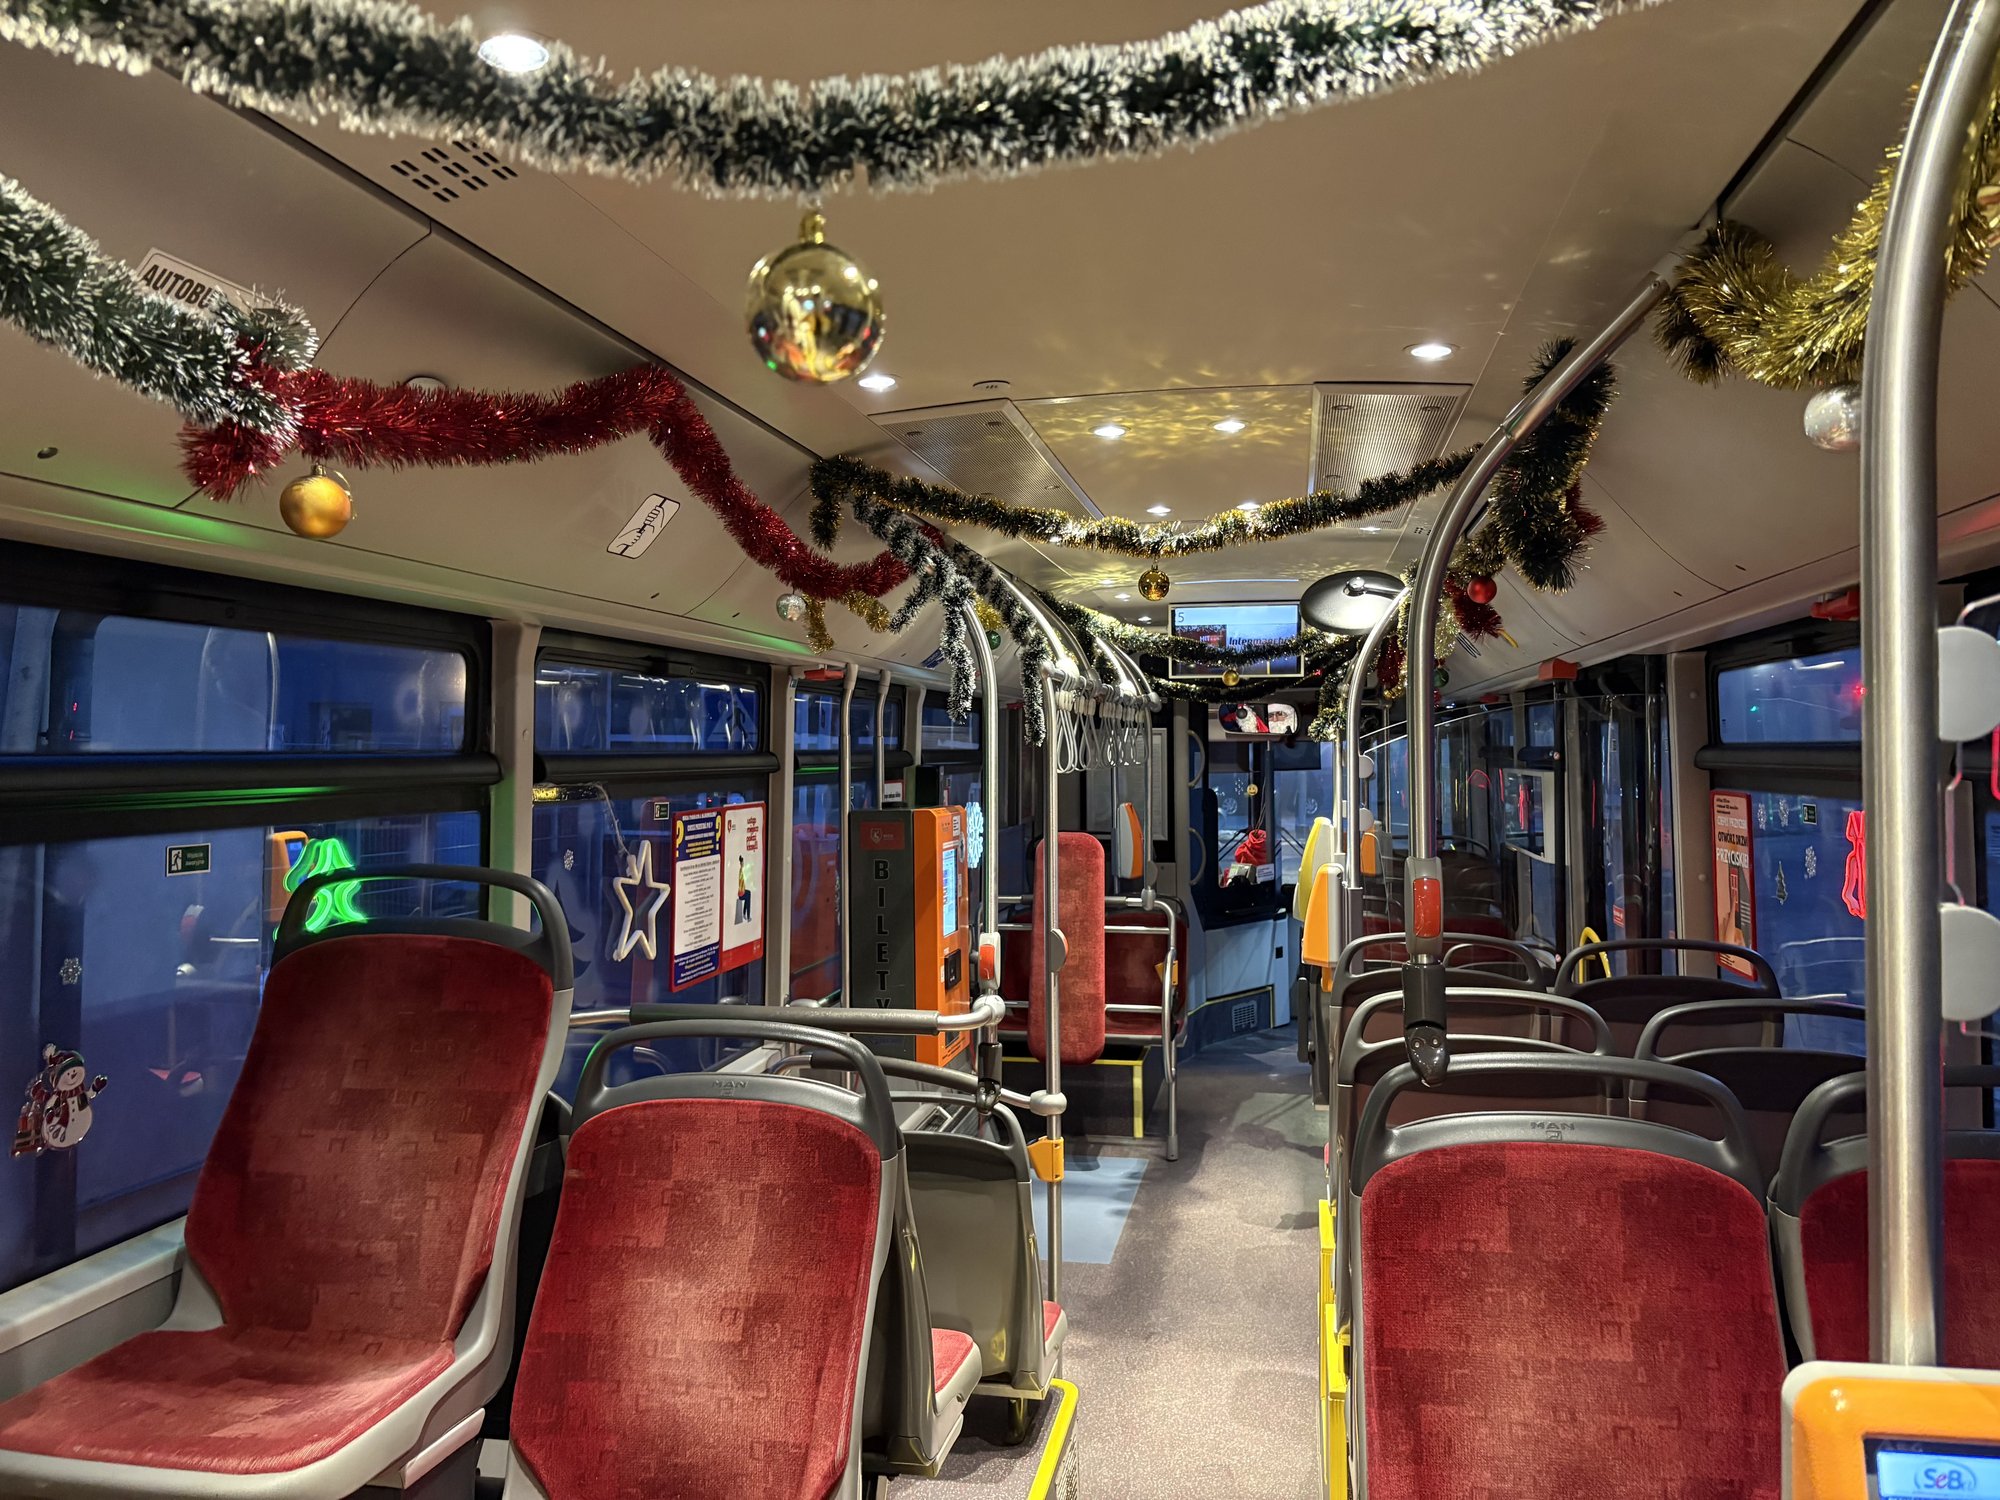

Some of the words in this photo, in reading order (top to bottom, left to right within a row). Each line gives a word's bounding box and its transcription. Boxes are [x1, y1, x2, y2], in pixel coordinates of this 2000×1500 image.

[1177, 611, 1185, 623] 5
[712, 1080, 749, 1088] MAN
[1530, 1121, 1575, 1130] MAN
